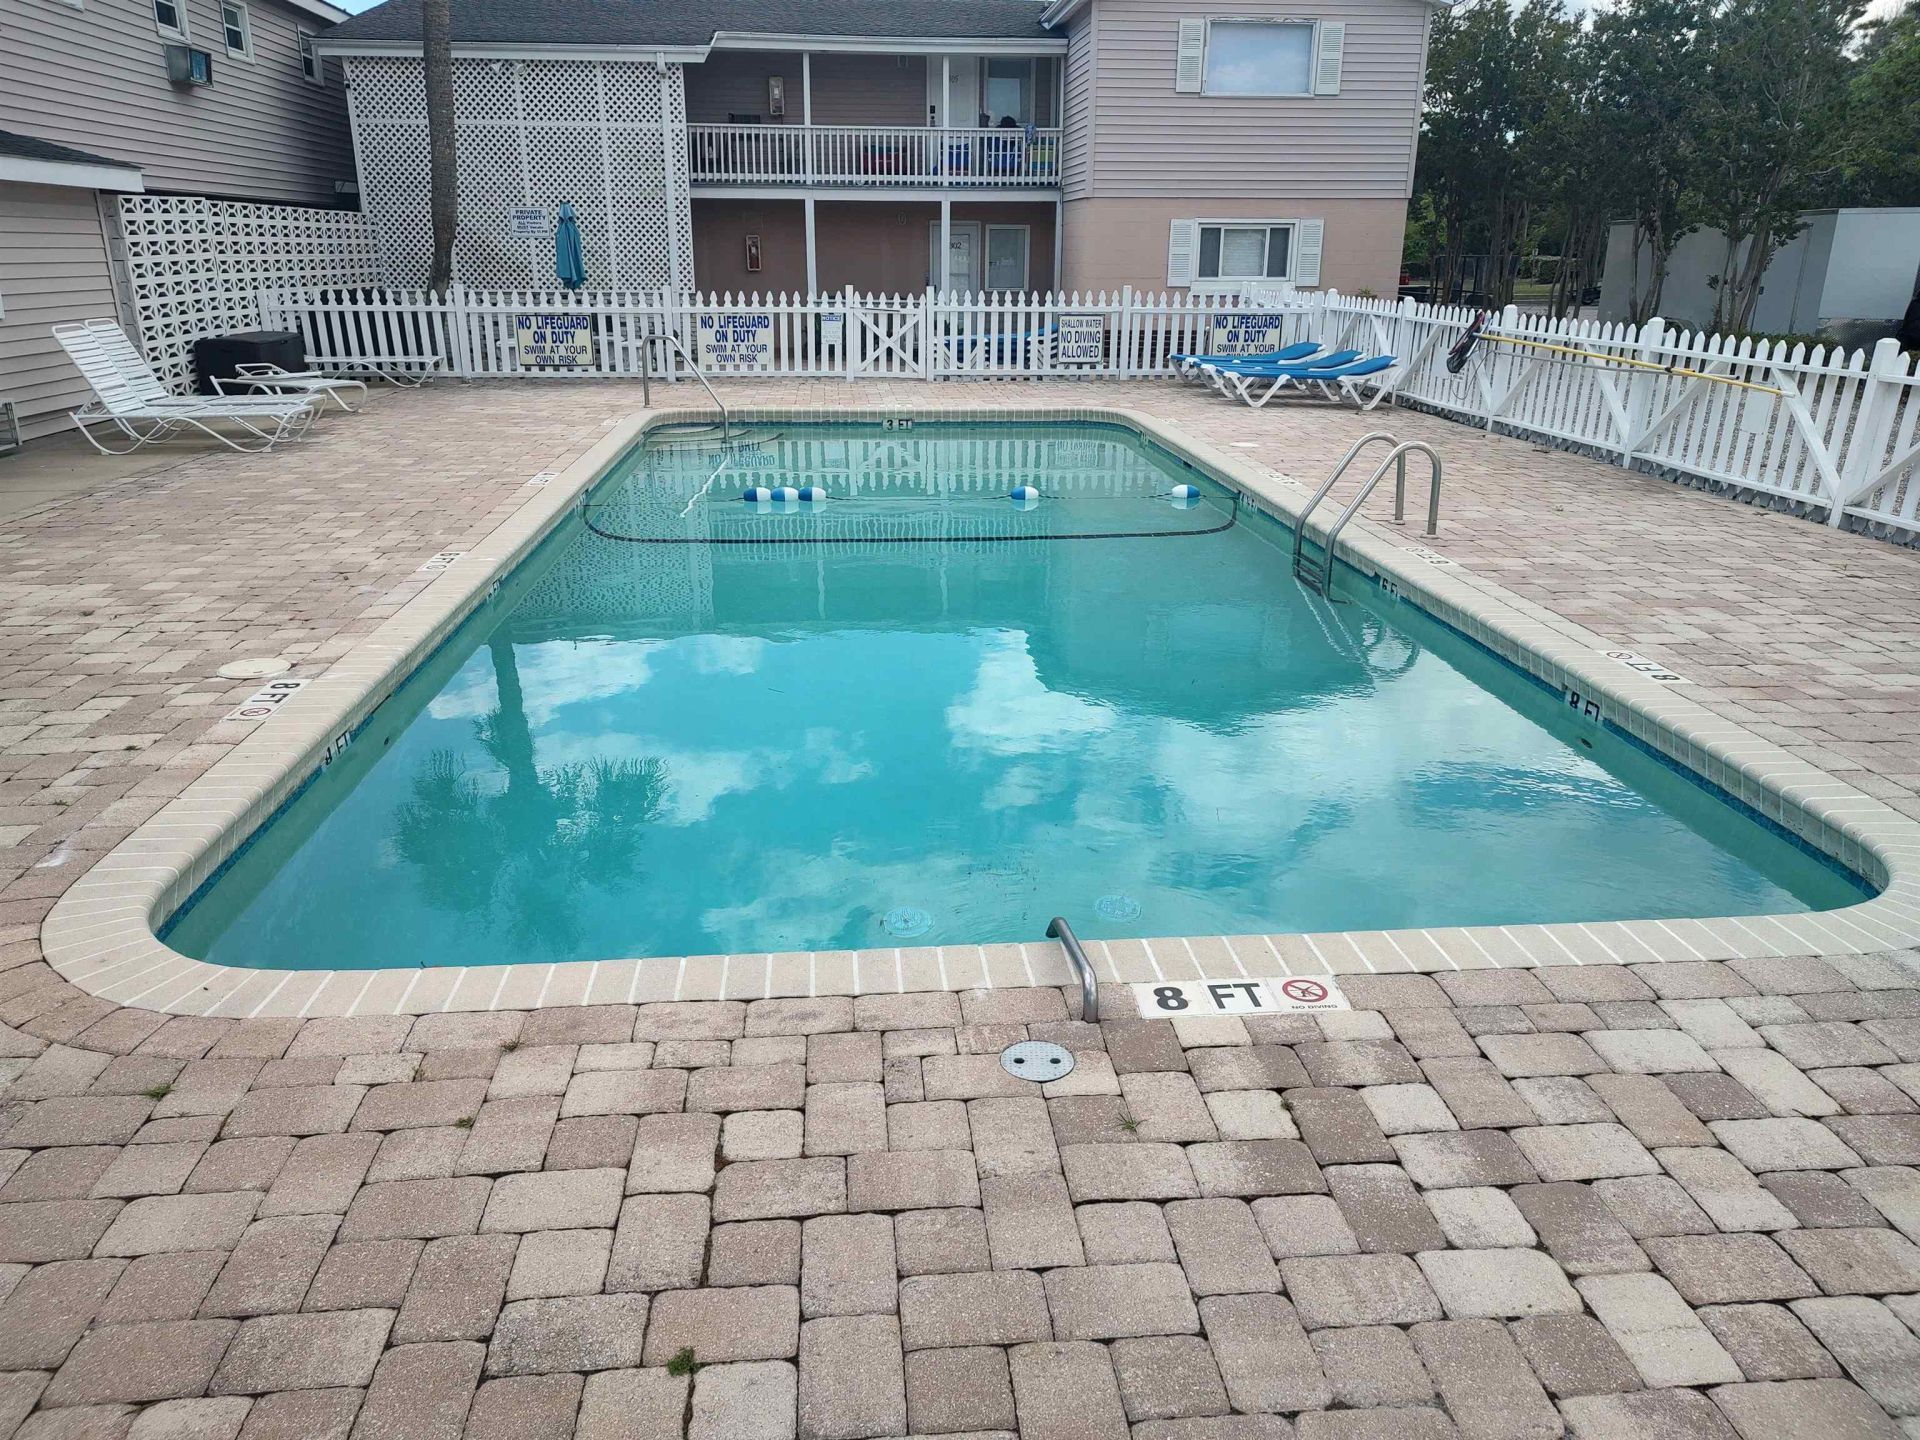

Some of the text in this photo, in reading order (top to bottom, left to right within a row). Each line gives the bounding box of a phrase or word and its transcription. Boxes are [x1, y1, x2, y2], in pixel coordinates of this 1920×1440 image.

[518, 316, 588, 330] NO LIFEGUARD
[700, 316, 770, 328] NO LIFEGUARD
[1061, 320, 1101, 328] SHALLOW WATER
[1216, 316, 1280, 329] NO LIFEGUARD
[533, 331, 575, 344] ON DUTY
[715, 330, 756, 342] ON DUTY
[1061, 330, 1100, 343] NO DIVING
[1227, 330, 1267, 342] ON DUTY
[524, 345, 587, 354] SWIM AT YOUR
[706, 344, 768, 353] SWIM AT YOUR
[1062, 345, 1100, 358] ALLOWED
[1216, 344, 1275, 353] SWIM AT YOUR
[535, 355, 578, 364] OWN RISK
[716, 354, 758, 363] OWN RISK
[886, 420, 893, 430] 3
[1625, 662, 1664, 671] FT
[252, 693, 289, 703] FT
[1570, 691, 1600, 722] 8 FT
[335, 730, 349, 755] FT
[1153, 983, 1262, 1010] 8 FT
